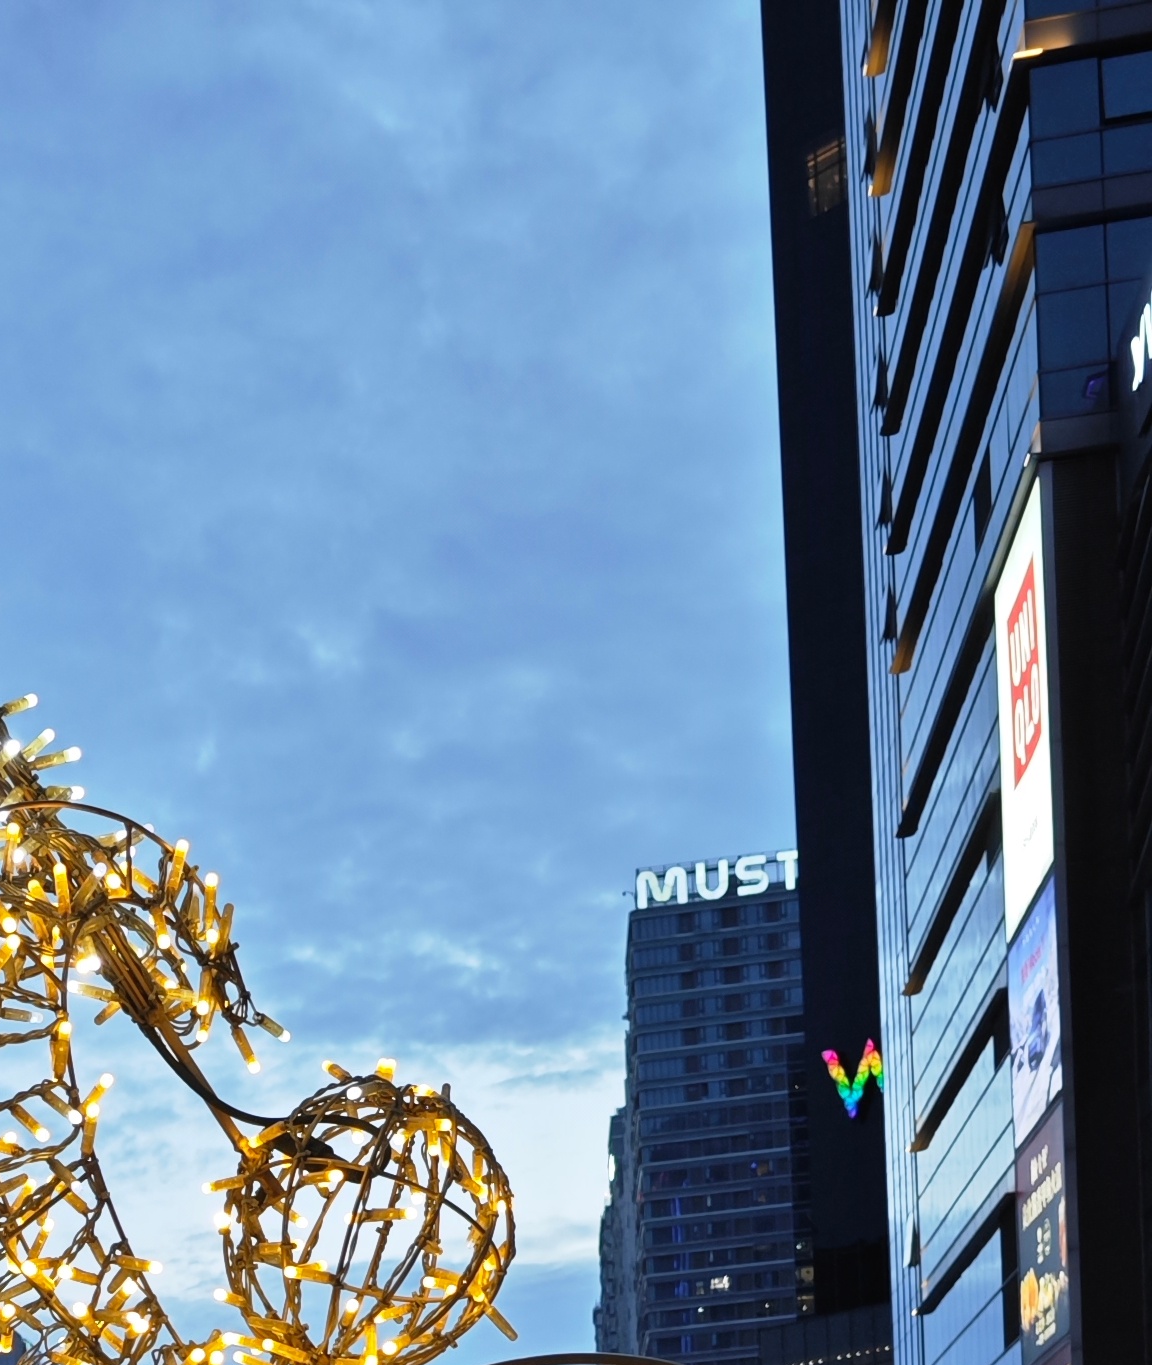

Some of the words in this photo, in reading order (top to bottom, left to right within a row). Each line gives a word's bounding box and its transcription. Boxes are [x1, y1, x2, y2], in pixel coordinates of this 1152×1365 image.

[1010, 589, 1035, 687] UNI
[1014, 663, 1039, 766] QLO
[636, 850, 798, 909] MUST
